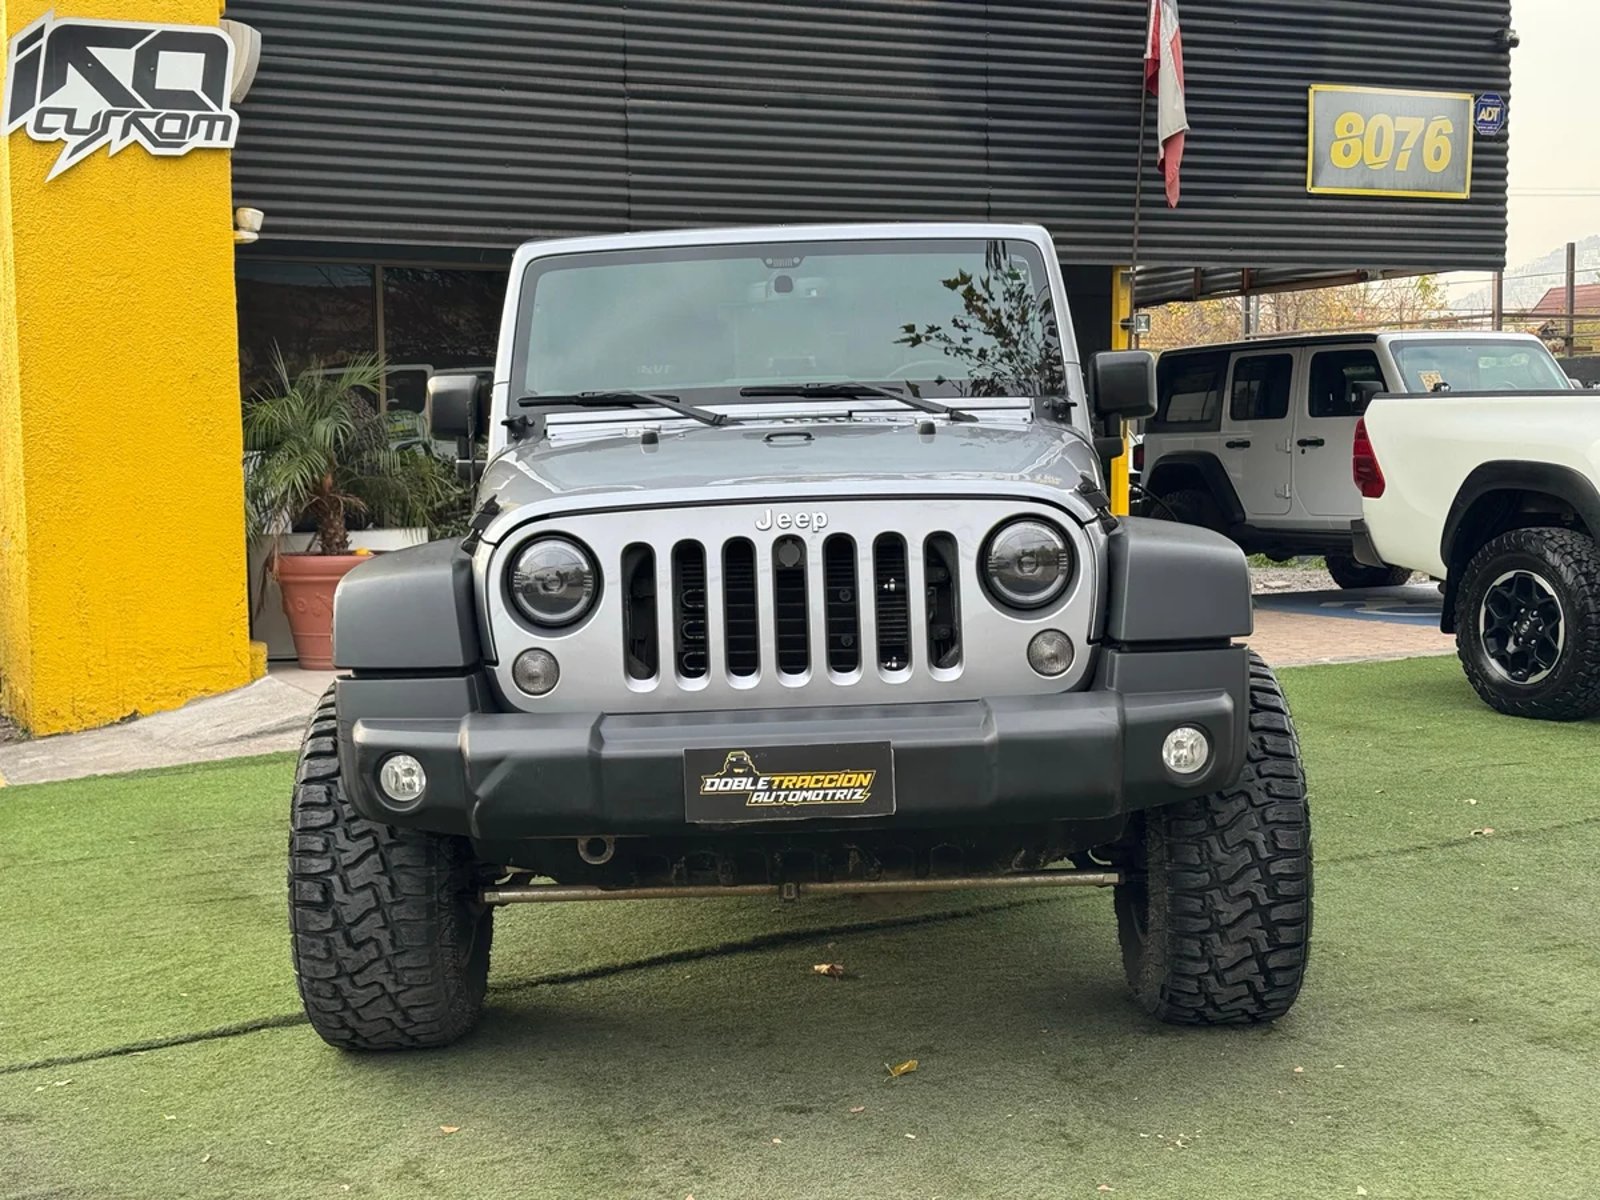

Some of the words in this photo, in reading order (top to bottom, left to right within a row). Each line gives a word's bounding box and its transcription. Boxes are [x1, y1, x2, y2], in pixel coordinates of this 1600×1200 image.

[1477, 107, 1500, 122] ADT
[1330, 111, 1453, 172] 8076
[755, 508, 828, 532] Jeep
[751, 788, 864, 803] AUTOMOTRIZ
